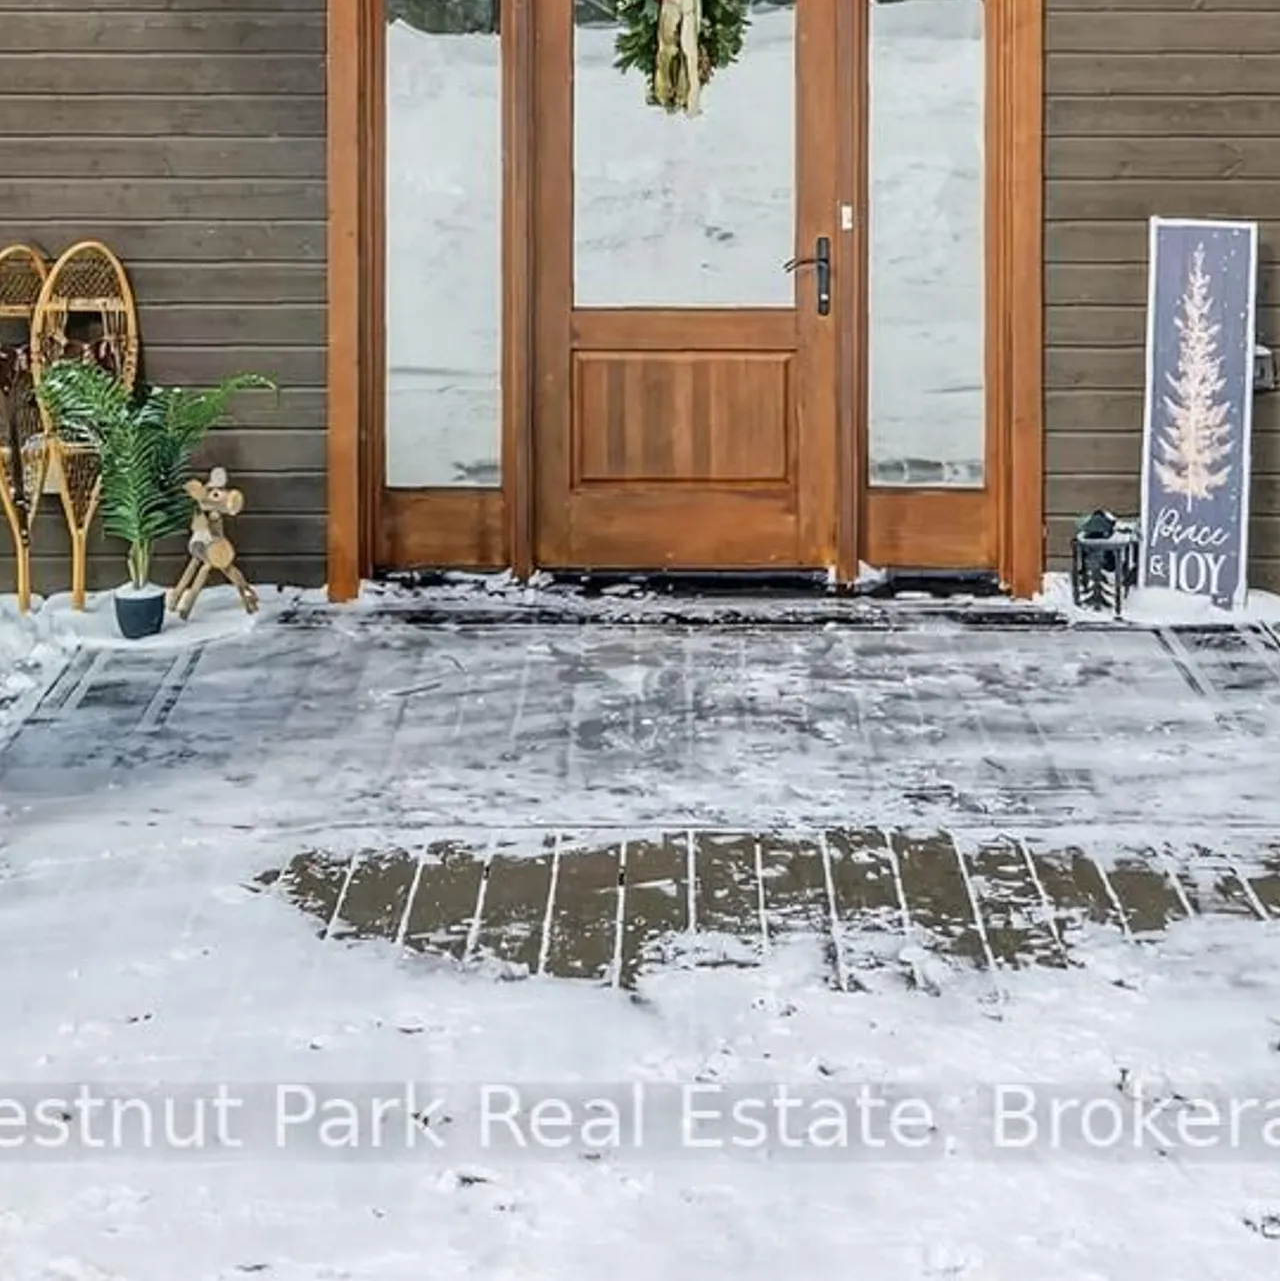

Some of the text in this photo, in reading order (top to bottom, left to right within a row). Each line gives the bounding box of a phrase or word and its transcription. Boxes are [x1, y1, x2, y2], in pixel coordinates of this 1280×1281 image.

[1150, 505, 1231, 548] Peace
[1149, 549, 1227, 595] & JOY
